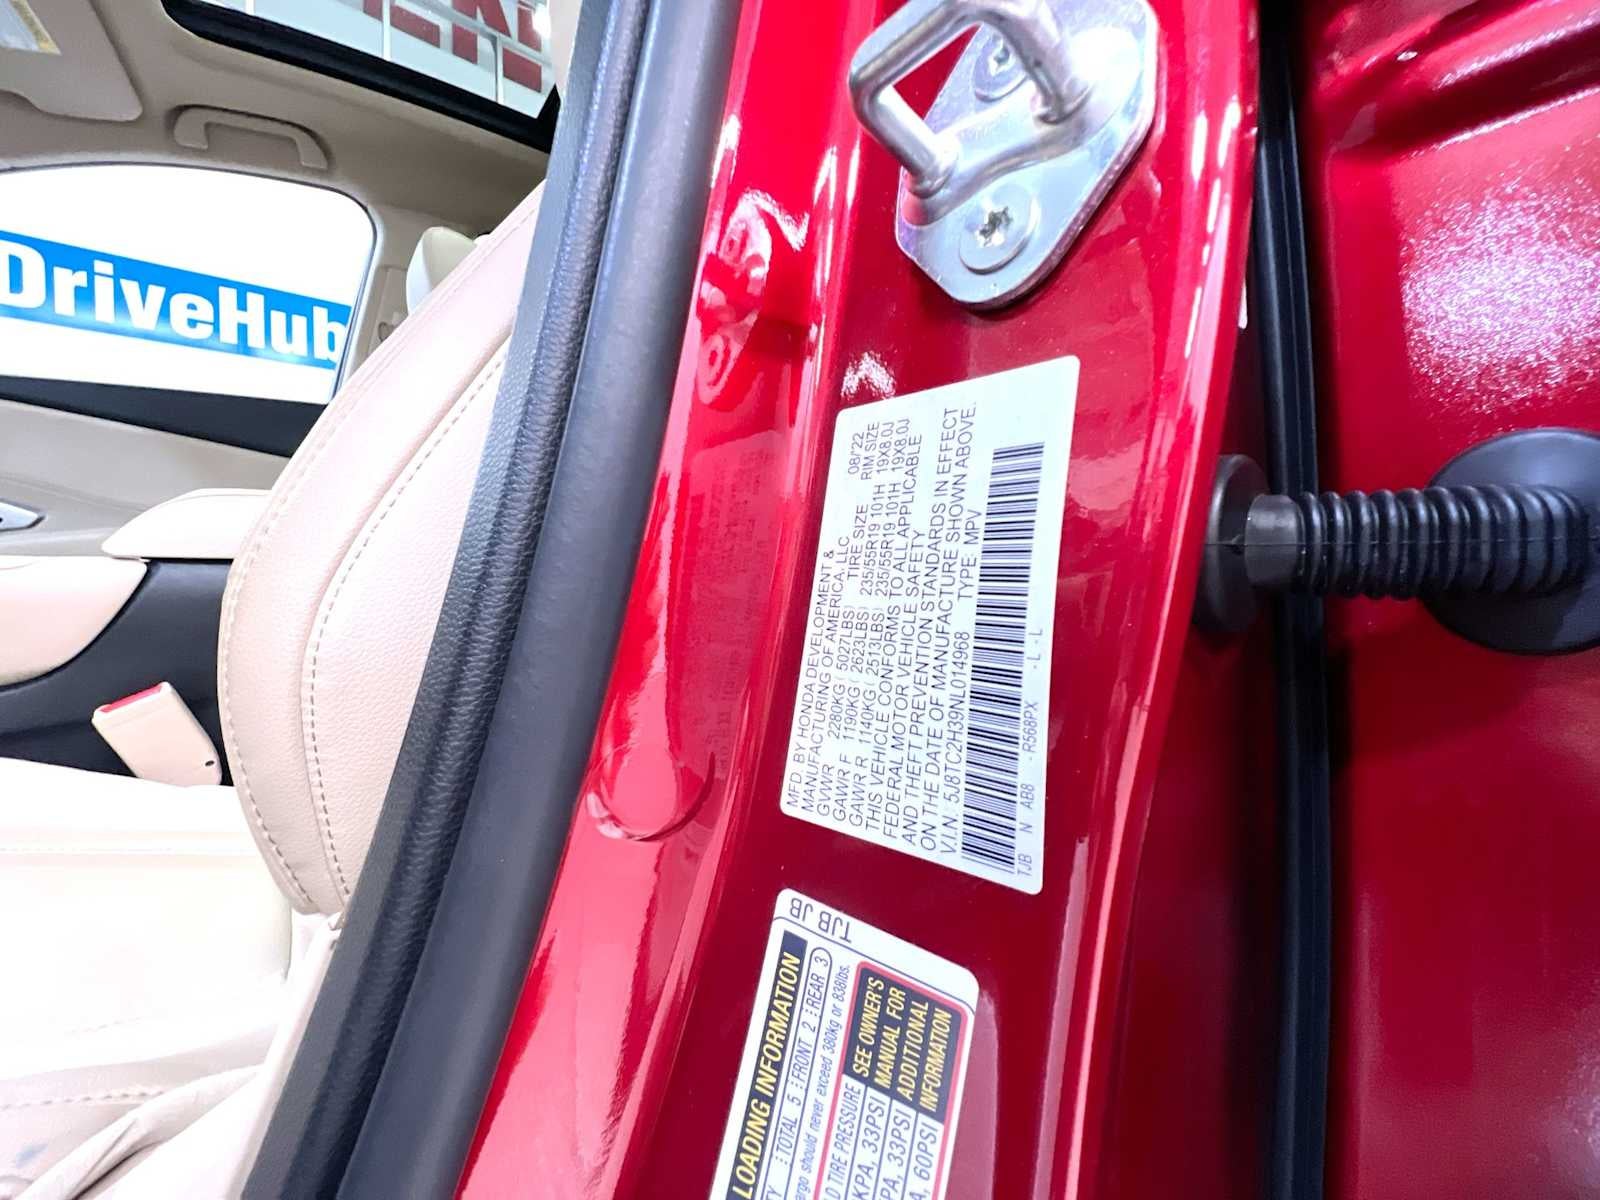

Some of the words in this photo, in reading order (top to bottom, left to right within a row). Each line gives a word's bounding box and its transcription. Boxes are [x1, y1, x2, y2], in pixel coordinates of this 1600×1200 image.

[0, 238, 346, 362] DriveHub
[864, 422, 880, 452] SIZE
[875, 421, 895, 474] 19X8.0J
[890, 418, 910, 472] 19X8.0J
[936, 408, 958, 475] EFFECT
[954, 402, 976, 469] ABOVE.
[860, 455, 875, 481] RIM
[896, 434, 923, 539] APPLICABLE
[933, 480, 949, 497] IN
[852, 504, 869, 539] SIZE
[870, 484, 886, 518] 101H
[885, 482, 902, 517] 101H
[945, 473, 968, 543] SHOWN
[823, 549, 835, 559] &
[846, 544, 863, 580] TIRE
[859, 523, 881, 596] 235/55R19
[874, 522, 896, 597] 235/55R19
[892, 543, 909, 573] ALL
[905, 529, 926, 598] SAFETY
[920, 502, 946, 612] STANDARDS
[888, 576, 904, 598] TO
[805, 563, 832, 679] DEVELOPMENT
[896, 603, 918, 678] VEHICLE
[930, 549, 959, 691] MANUFACTURE
[801, 672, 832, 813] MANUFACTURING
[821, 645, 834, 668] OF
[835, 536, 850, 564] LLC
[877, 605, 901, 707] CONFORMS
[909, 617, 934, 737] PREVENTION
[942, 631, 970, 804] 5J8TC2H39NL014968
[963, 509, 982, 545] MPV
[796, 682, 816, 739] HONDA
[890, 684, 910, 751] MOTOR
[928, 695, 945, 722] OF
[793, 742, 806, 764] BY
[839, 753, 852, 765] F
[854, 755, 869, 769] R
[869, 711, 890, 786] VEHICLE
[904, 740, 923, 798] THEFT
[924, 726, 943, 776] DATE
[816, 764, 835, 817] GVWR
[832, 768, 851, 822] GAWR
[848, 773, 867, 827] GAWR
[865, 791, 883, 830] THIS
[882, 756, 904, 839] FEDERAL
[921, 779, 940, 816] THE
[1019, 783, 1035, 810] AB8
[901, 805, 919, 847] AND
[920, 822, 937, 851] ON
[1019, 821, 1033, 834] N
[1017, 853, 1032, 876] TJB
[790, 897, 813, 923] JB
[818, 918, 852, 944] TJB
[814, 954, 828, 967] 3
[805, 971, 825, 1011] REAR
[830, 1003, 842, 1018] or
[858, 975, 885, 1047] OWNER'S
[885, 985, 907, 1021] FOR
[801, 1020, 816, 1032] 2
[821, 1017, 842, 1056] 380kg
[896, 996, 929, 1101] ADDITIONAL
[731, 1094, 770, 1200] LOADING
[754, 948, 800, 1099] INFORMATION
[791, 1036, 812, 1083] FRONT
[814, 1054, 832, 1097] exceed
[852, 1045, 872, 1078] SEE
[873, 1020, 900, 1089] MANUAL
[918, 1006, 952, 1112] INFORMATION
[787, 1093, 801, 1106] 5
[808, 1097, 824, 1133] never
[834, 1081, 861, 1155] PRESSURE
[775, 1111, 797, 1157] TOTAL
[861, 1094, 887, 1155] 33PSI
[886, 1107, 912, 1168] 33PSI
[798, 1131, 818, 1174] should
[827, 1153, 848, 1186] TIRE
[912, 1121, 938, 1182] 60PSI
[879, 1167, 903, 1200] PA,
